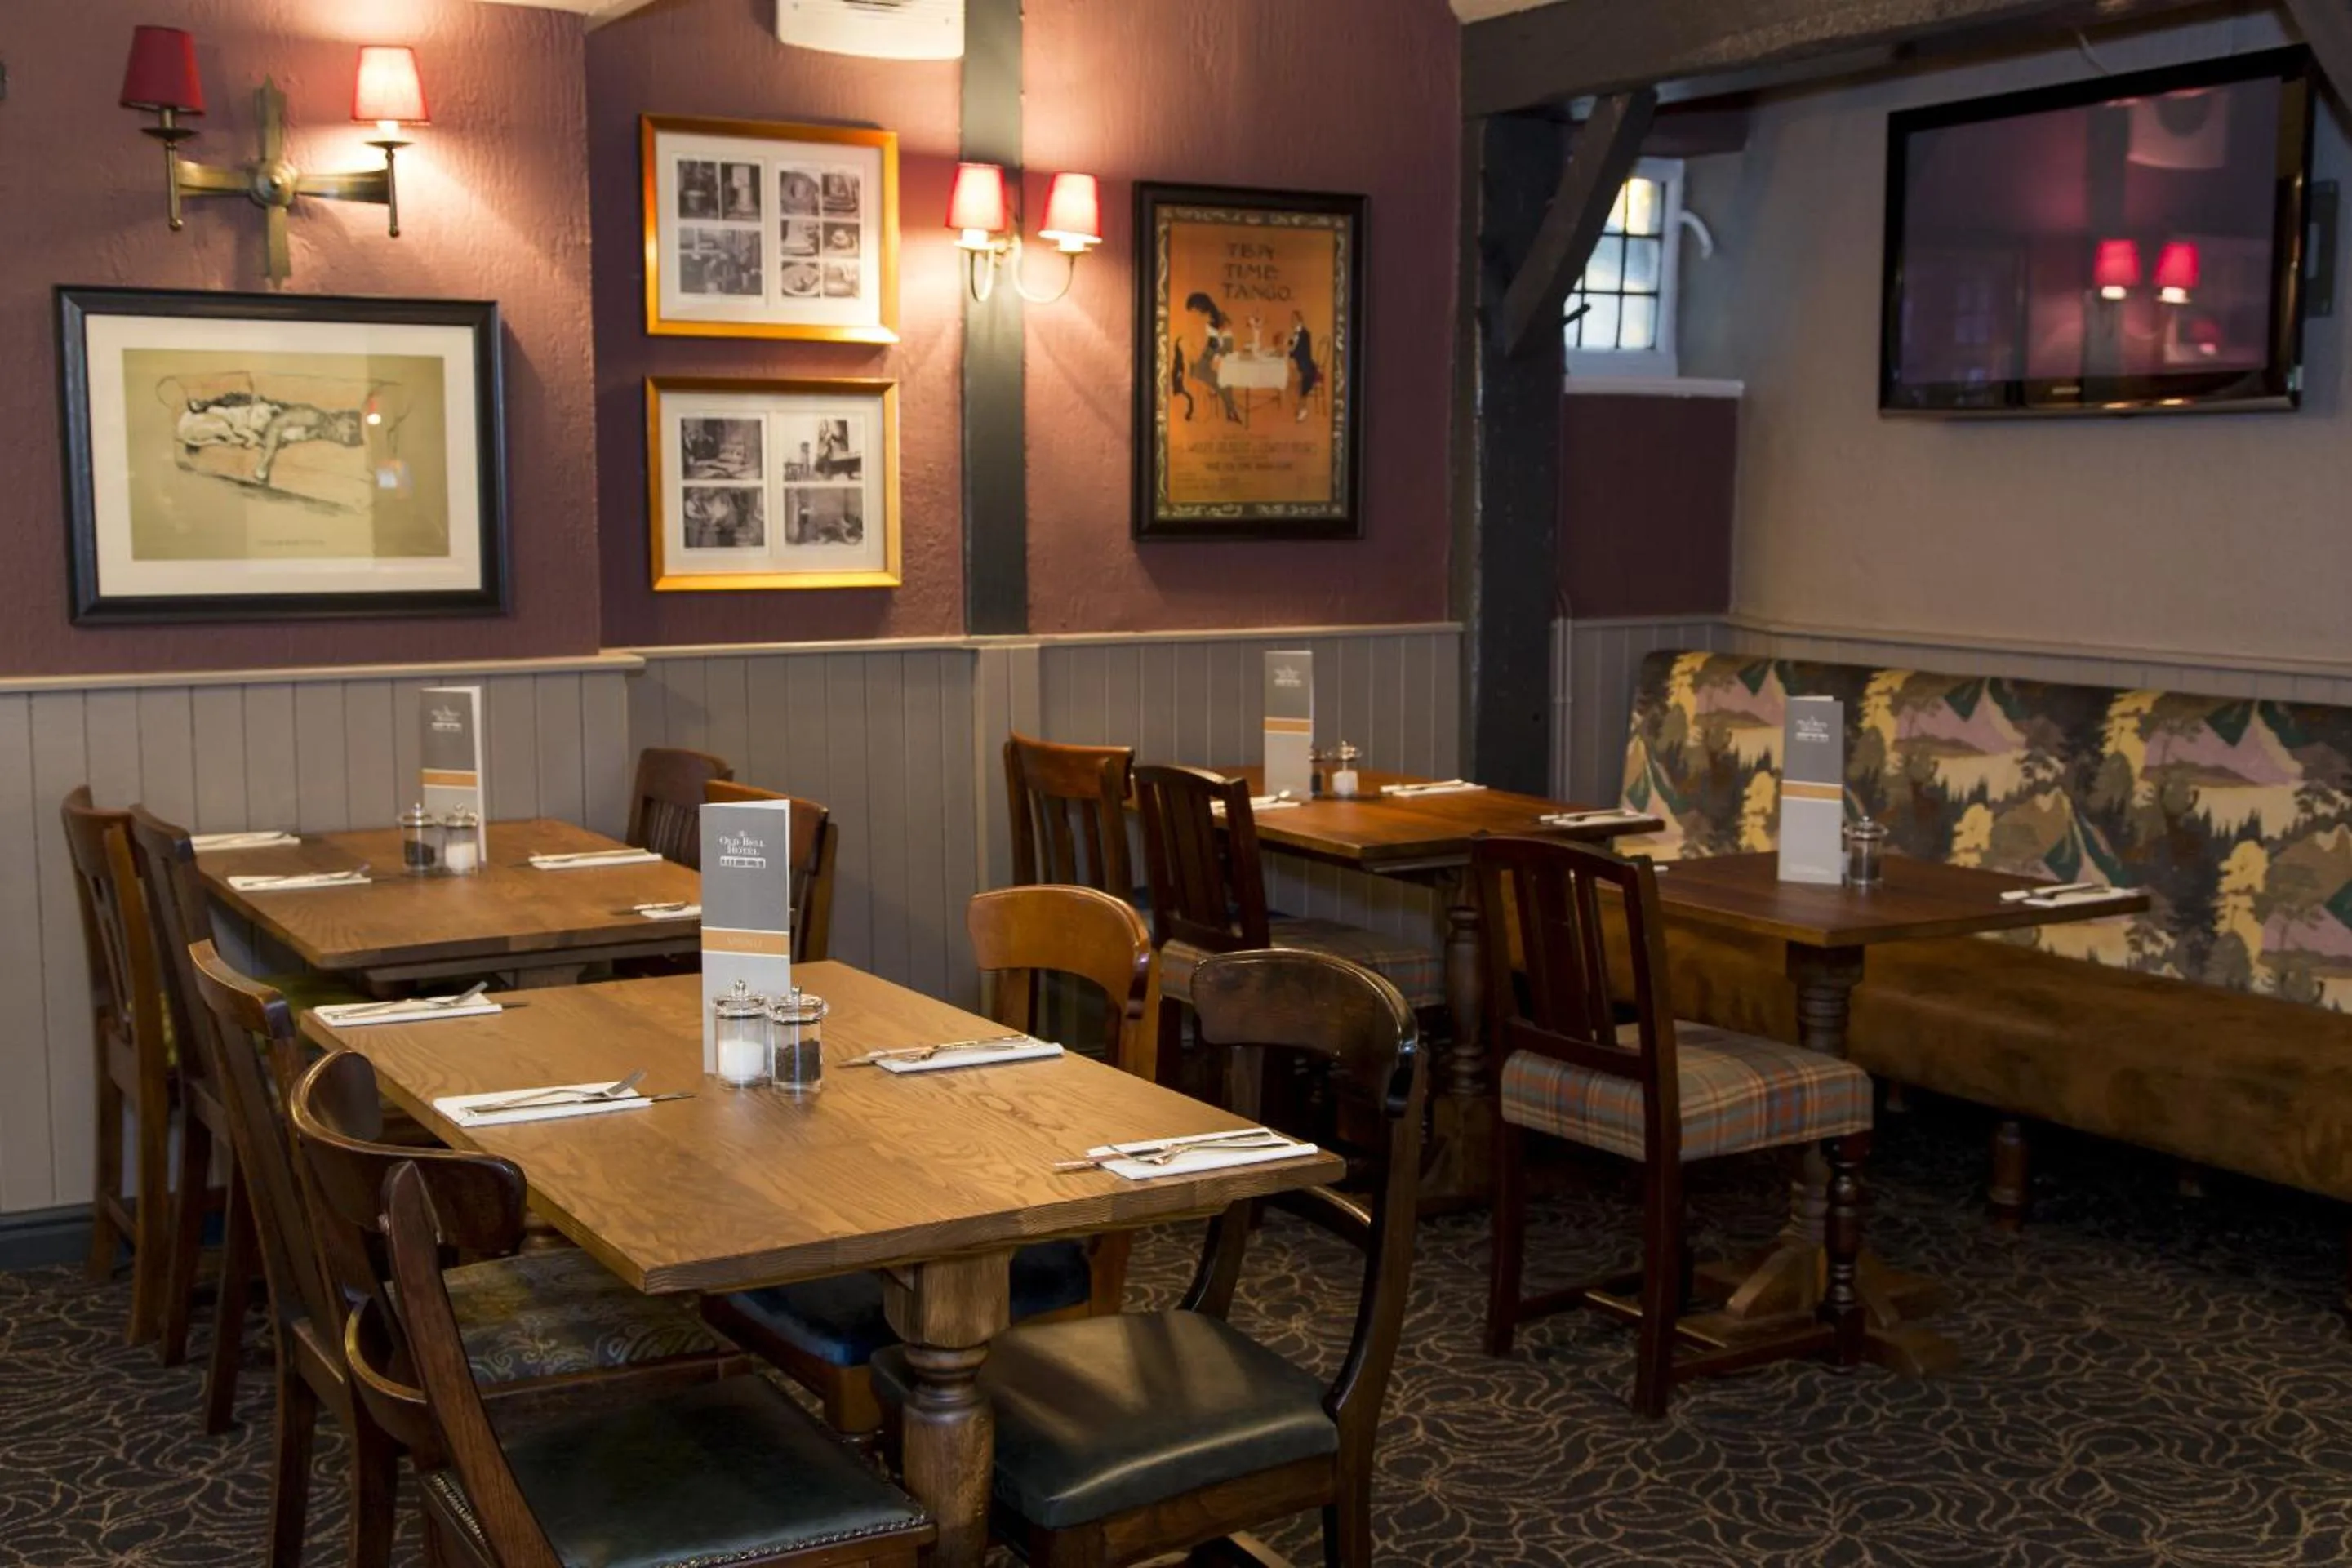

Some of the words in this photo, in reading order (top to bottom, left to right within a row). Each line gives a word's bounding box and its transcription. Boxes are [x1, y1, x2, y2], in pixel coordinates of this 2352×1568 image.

[1223, 263, 1280, 280] TIME
[719, 836, 740, 846] OLD
[742, 837, 767, 847] BELL
[727, 846, 760, 855] HOTEL
